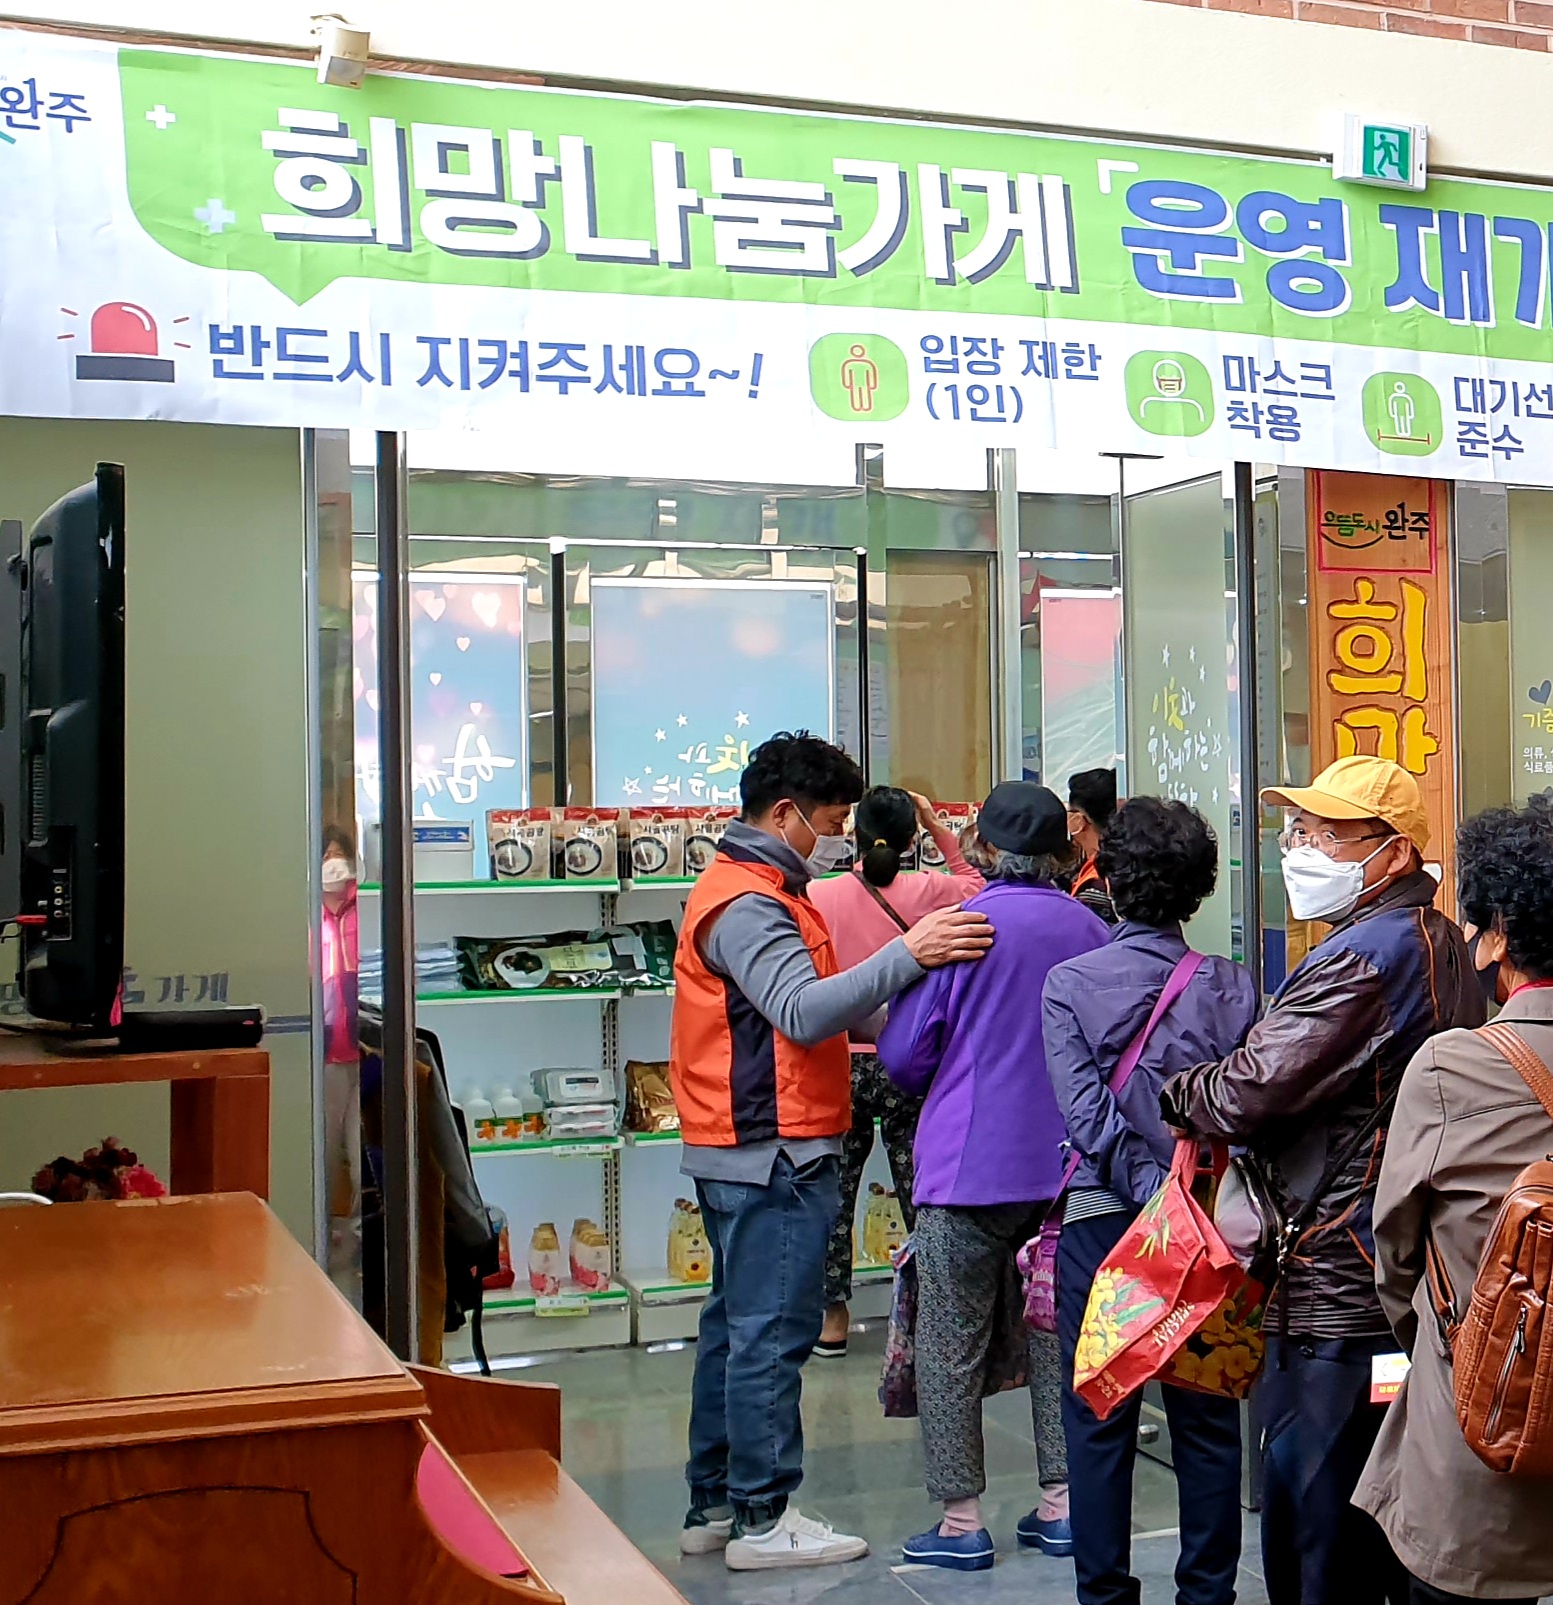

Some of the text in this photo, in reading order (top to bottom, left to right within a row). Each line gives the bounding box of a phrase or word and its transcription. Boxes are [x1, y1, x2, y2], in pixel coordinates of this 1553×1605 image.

[0, 77, 92, 134] 완주
[260, 106, 1081, 294] 희망나눔가게
[209, 324, 763, 399] 반드시 지켜주세요~!
[920, 334, 1102, 381] 입장 제한
[1222, 354, 1335, 400] 마스크
[926, 382, 1023, 423] (1인)
[1226, 400, 1301, 442] 착용
[1456, 420, 1524, 460] 준수
[1382, 501, 1429, 540] 완주
